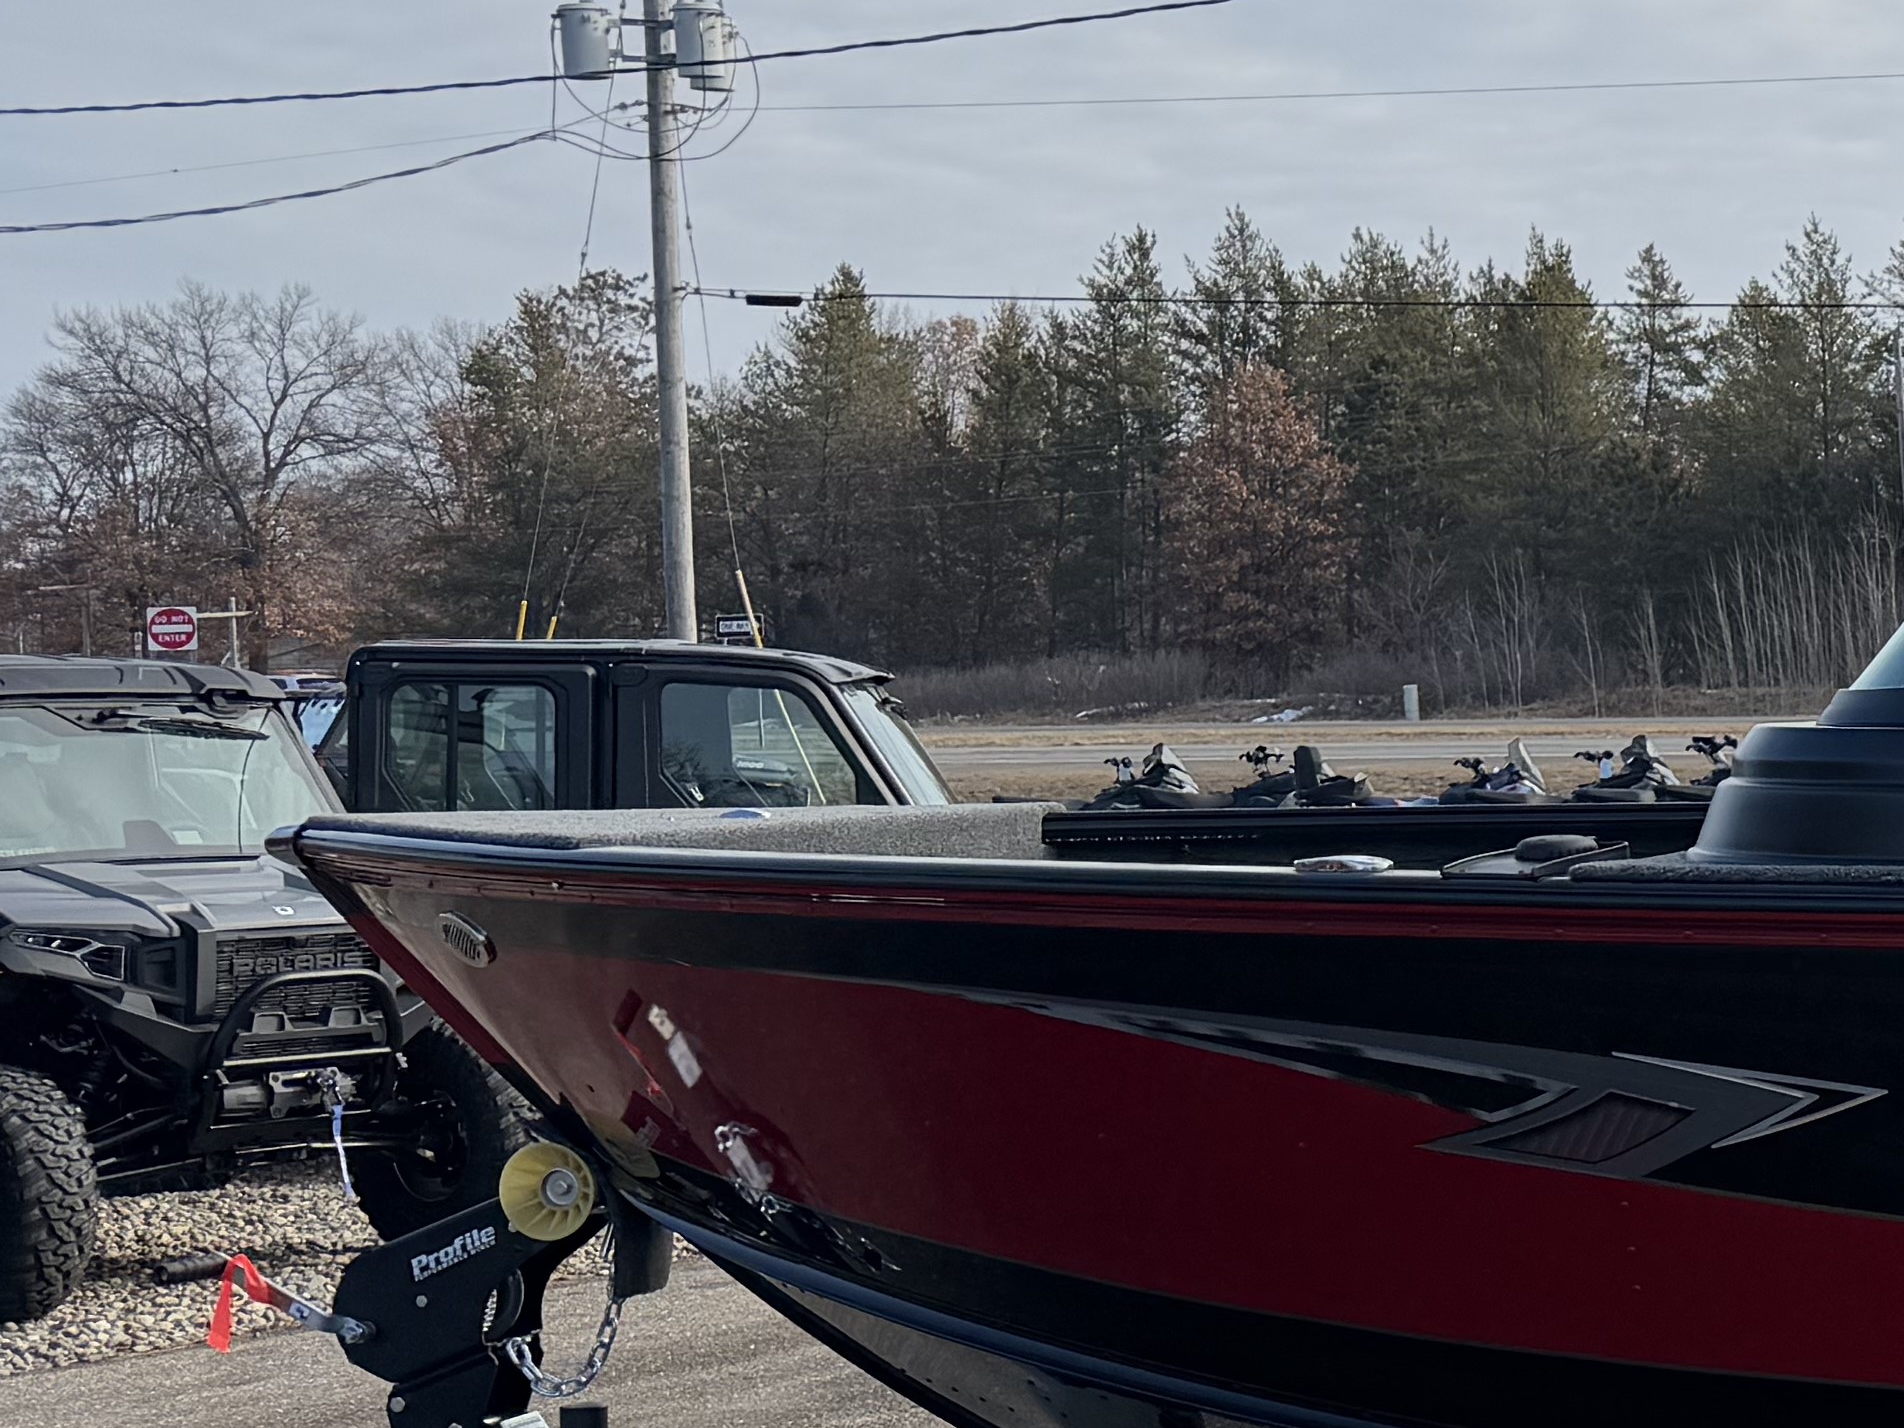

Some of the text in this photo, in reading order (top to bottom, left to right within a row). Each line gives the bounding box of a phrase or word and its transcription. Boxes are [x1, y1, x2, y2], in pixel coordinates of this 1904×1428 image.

[158, 633, 188, 643] ENTER
[232, 951, 366, 977] POLARIS
[411, 1226, 496, 1277] Profile
